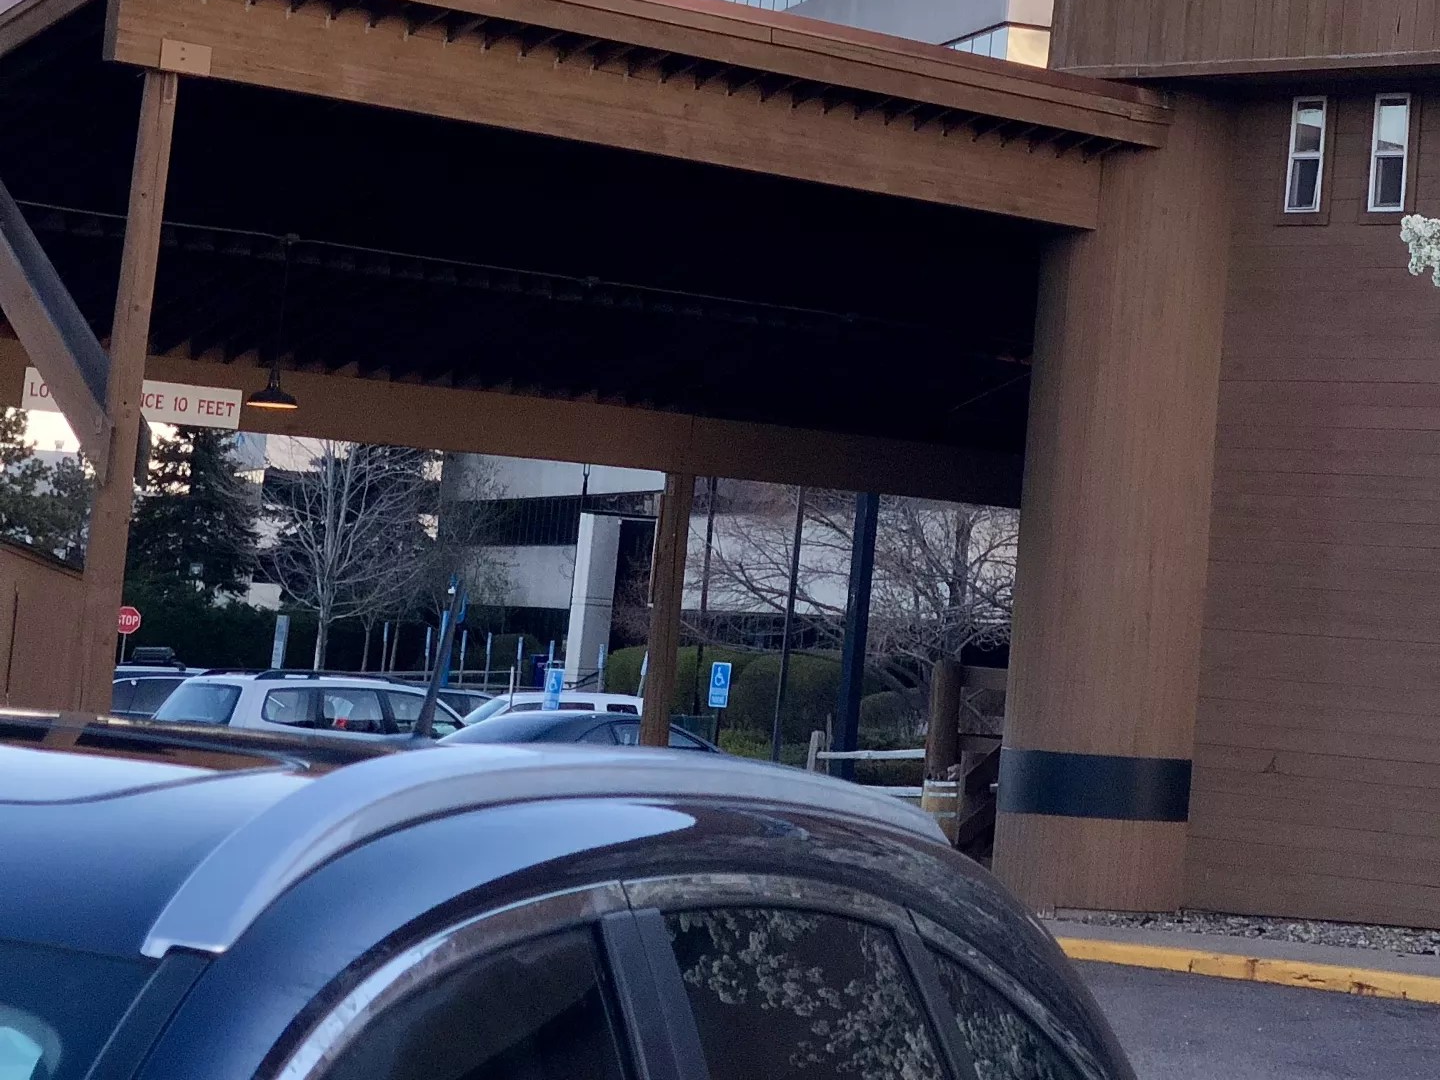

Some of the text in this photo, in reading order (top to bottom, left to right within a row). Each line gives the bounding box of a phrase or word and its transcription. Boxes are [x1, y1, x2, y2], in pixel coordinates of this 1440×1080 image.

[30, 382, 50, 398] LO
[174, 396, 188, 412] 10
[197, 400, 236, 417] FEET
